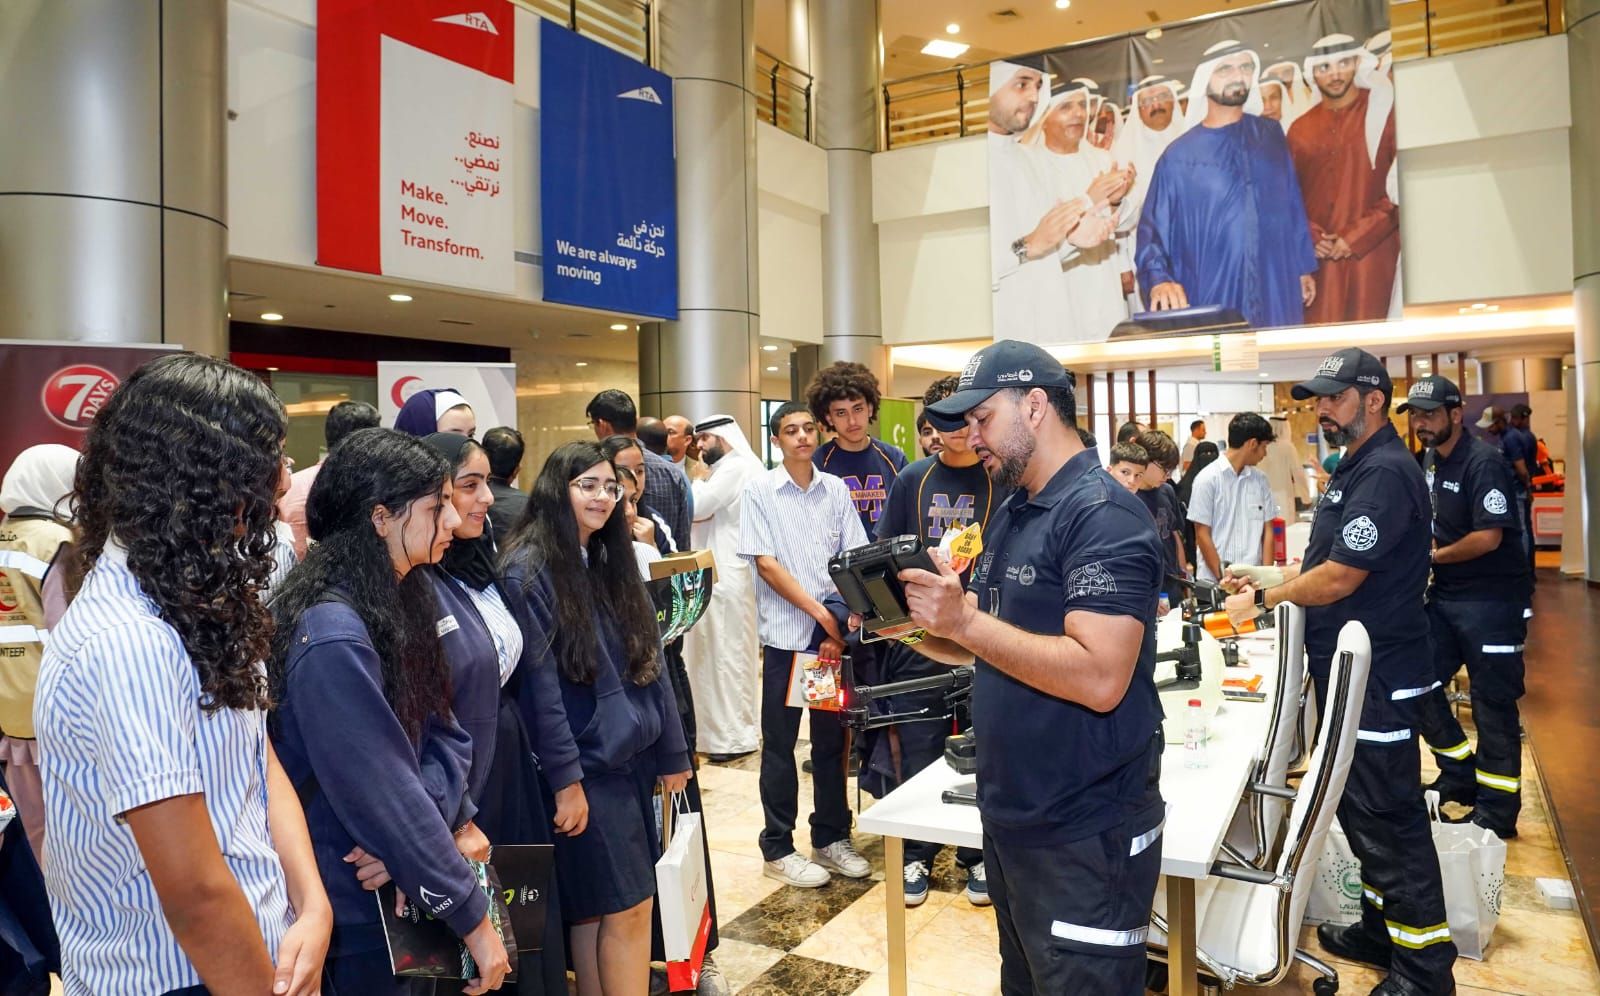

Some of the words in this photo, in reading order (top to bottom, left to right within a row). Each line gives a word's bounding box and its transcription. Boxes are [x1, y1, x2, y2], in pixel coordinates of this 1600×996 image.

[465, 13, 488, 31] RTA
[638, 89, 655, 101] RTA
[401, 179, 449, 206] Make.
[401, 204, 449, 230] Move.
[633, 220, 648, 239] في
[648, 223, 665, 239] نحن
[400, 229, 484, 260] Transform.
[616, 232, 643, 251] دائمة
[643, 240, 666, 258] حركة
[556, 239, 577, 257] We
[577, 247, 597, 262] are
[598, 250, 638, 271] always
[556, 264, 602, 286] moving
[58, 374, 103, 422] 7
[81, 379, 115, 419] DAYS
[431, 898, 454, 914] AMSI
